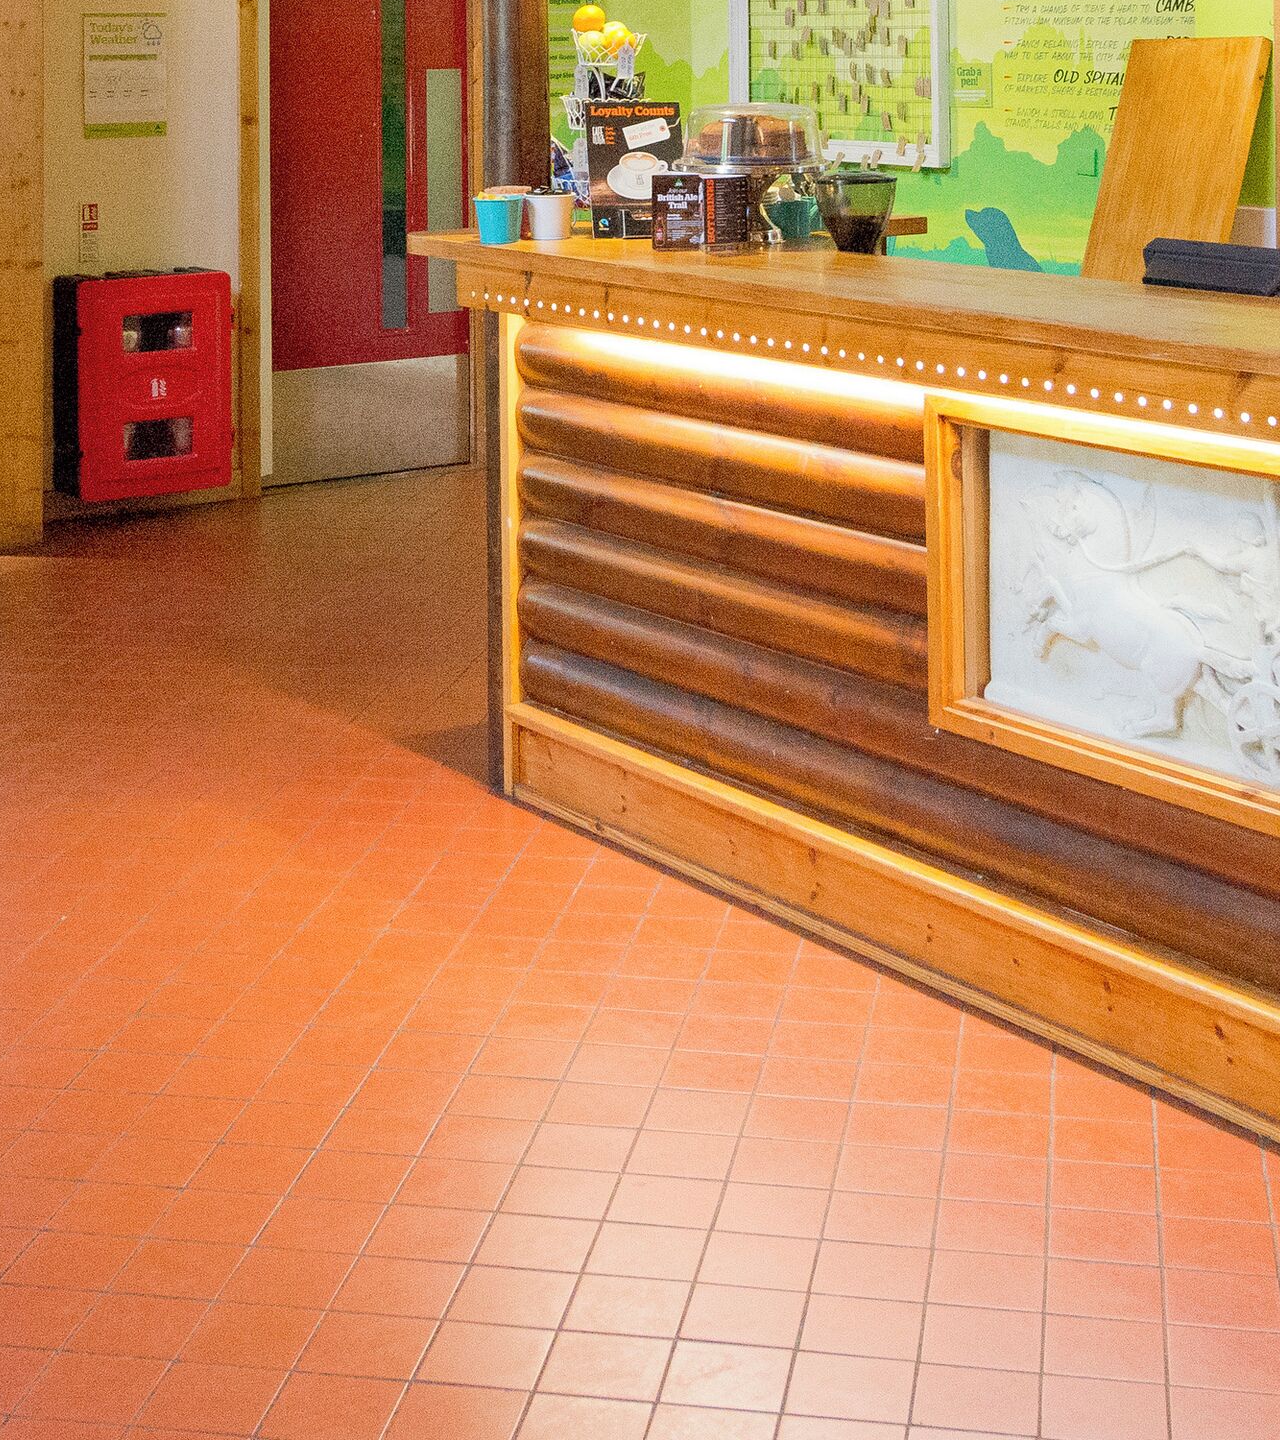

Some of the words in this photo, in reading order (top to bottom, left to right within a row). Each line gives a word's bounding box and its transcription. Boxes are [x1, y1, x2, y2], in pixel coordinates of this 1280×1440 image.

[89, 23, 133, 32] Today's
[90, 35, 138, 44] Weather
[957, 67, 976, 76] Grab
[1053, 69, 1080, 84] OLD
[961, 77, 978, 87] pen!
[590, 105, 633, 117] Loyalty
[634, 105, 675, 116] Counts
[657, 193, 684, 201] British
[684, 193, 698, 201] Ale
[706, 180, 715, 218] DRINKS
[668, 201, 688, 209] Trail
